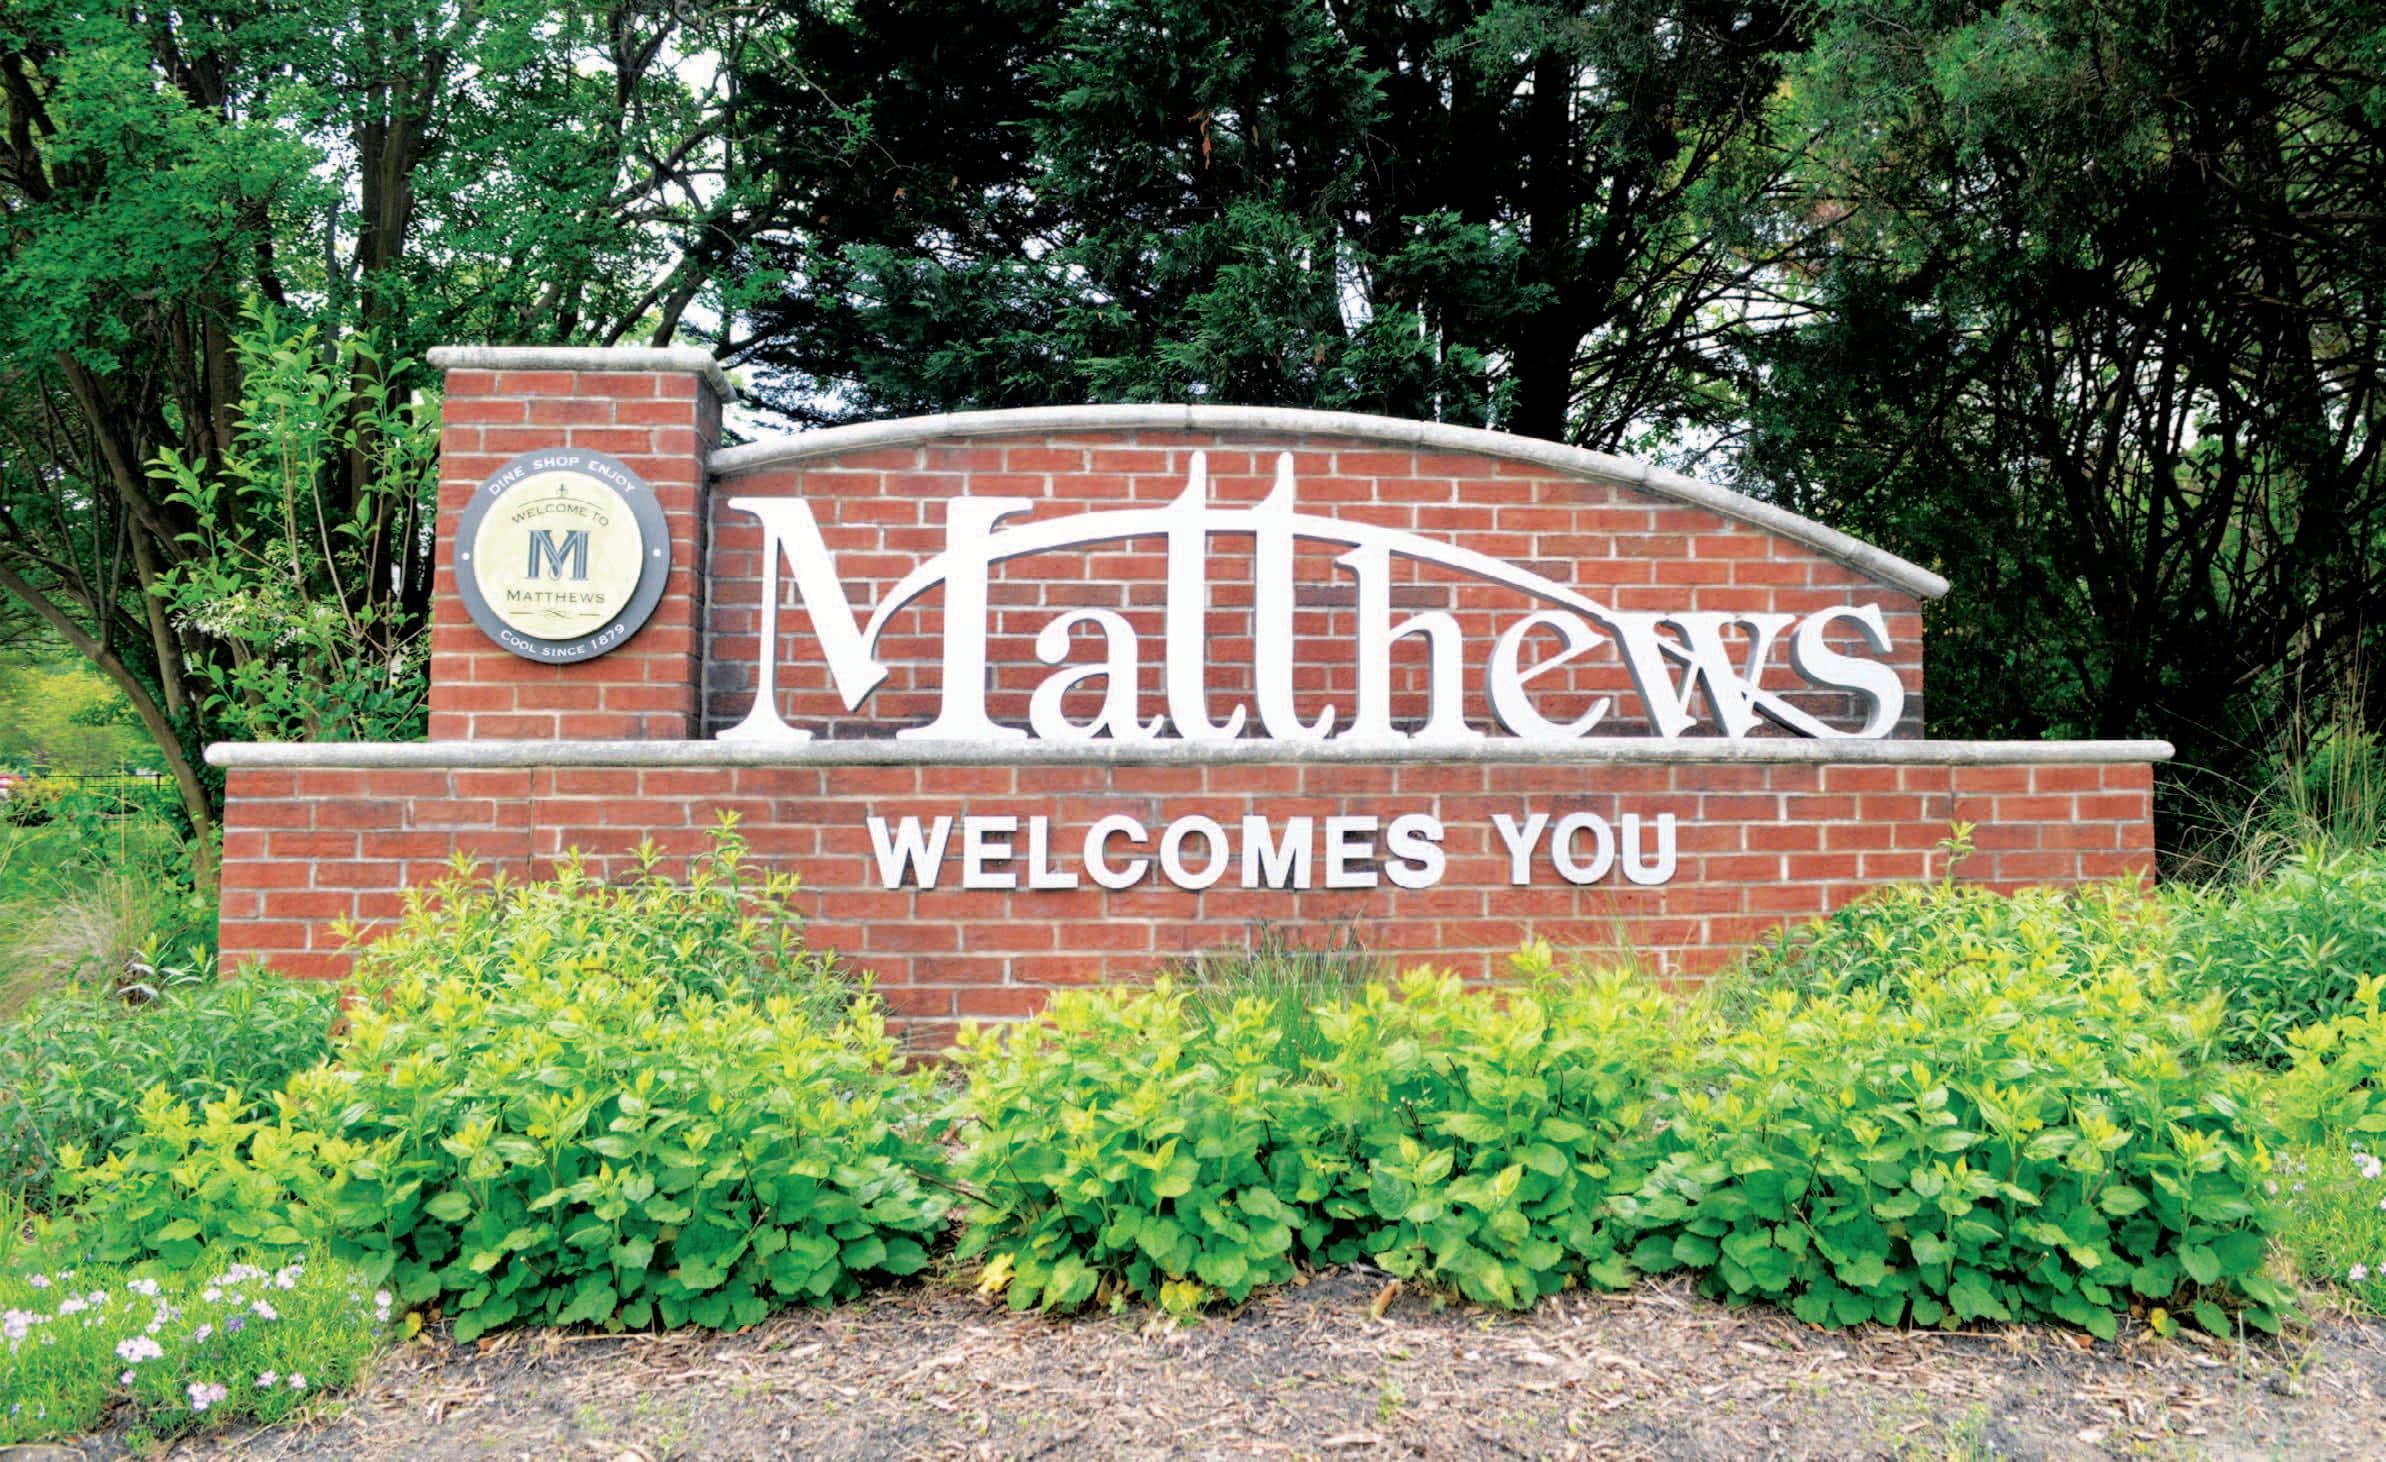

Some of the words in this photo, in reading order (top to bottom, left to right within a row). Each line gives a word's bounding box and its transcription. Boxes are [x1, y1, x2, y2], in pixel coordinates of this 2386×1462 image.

[488, 465, 526, 496] DINE
[532, 456, 581, 471] SHOP
[587, 460, 636, 493] ENJOY
[511, 503, 588, 525] WELCOME
[592, 513, 610, 527] TO
[525, 529, 592, 582] M
[506, 589, 606, 604] MATTHEWS
[715, 449, 1907, 741] Matthews
[500, 629, 537, 653] COOL
[541, 645, 585, 657] SINCE
[591, 623, 626, 649] 1879
[866, 813, 1447, 891] WELCOMES
[1491, 812, 1678, 887] YOU
